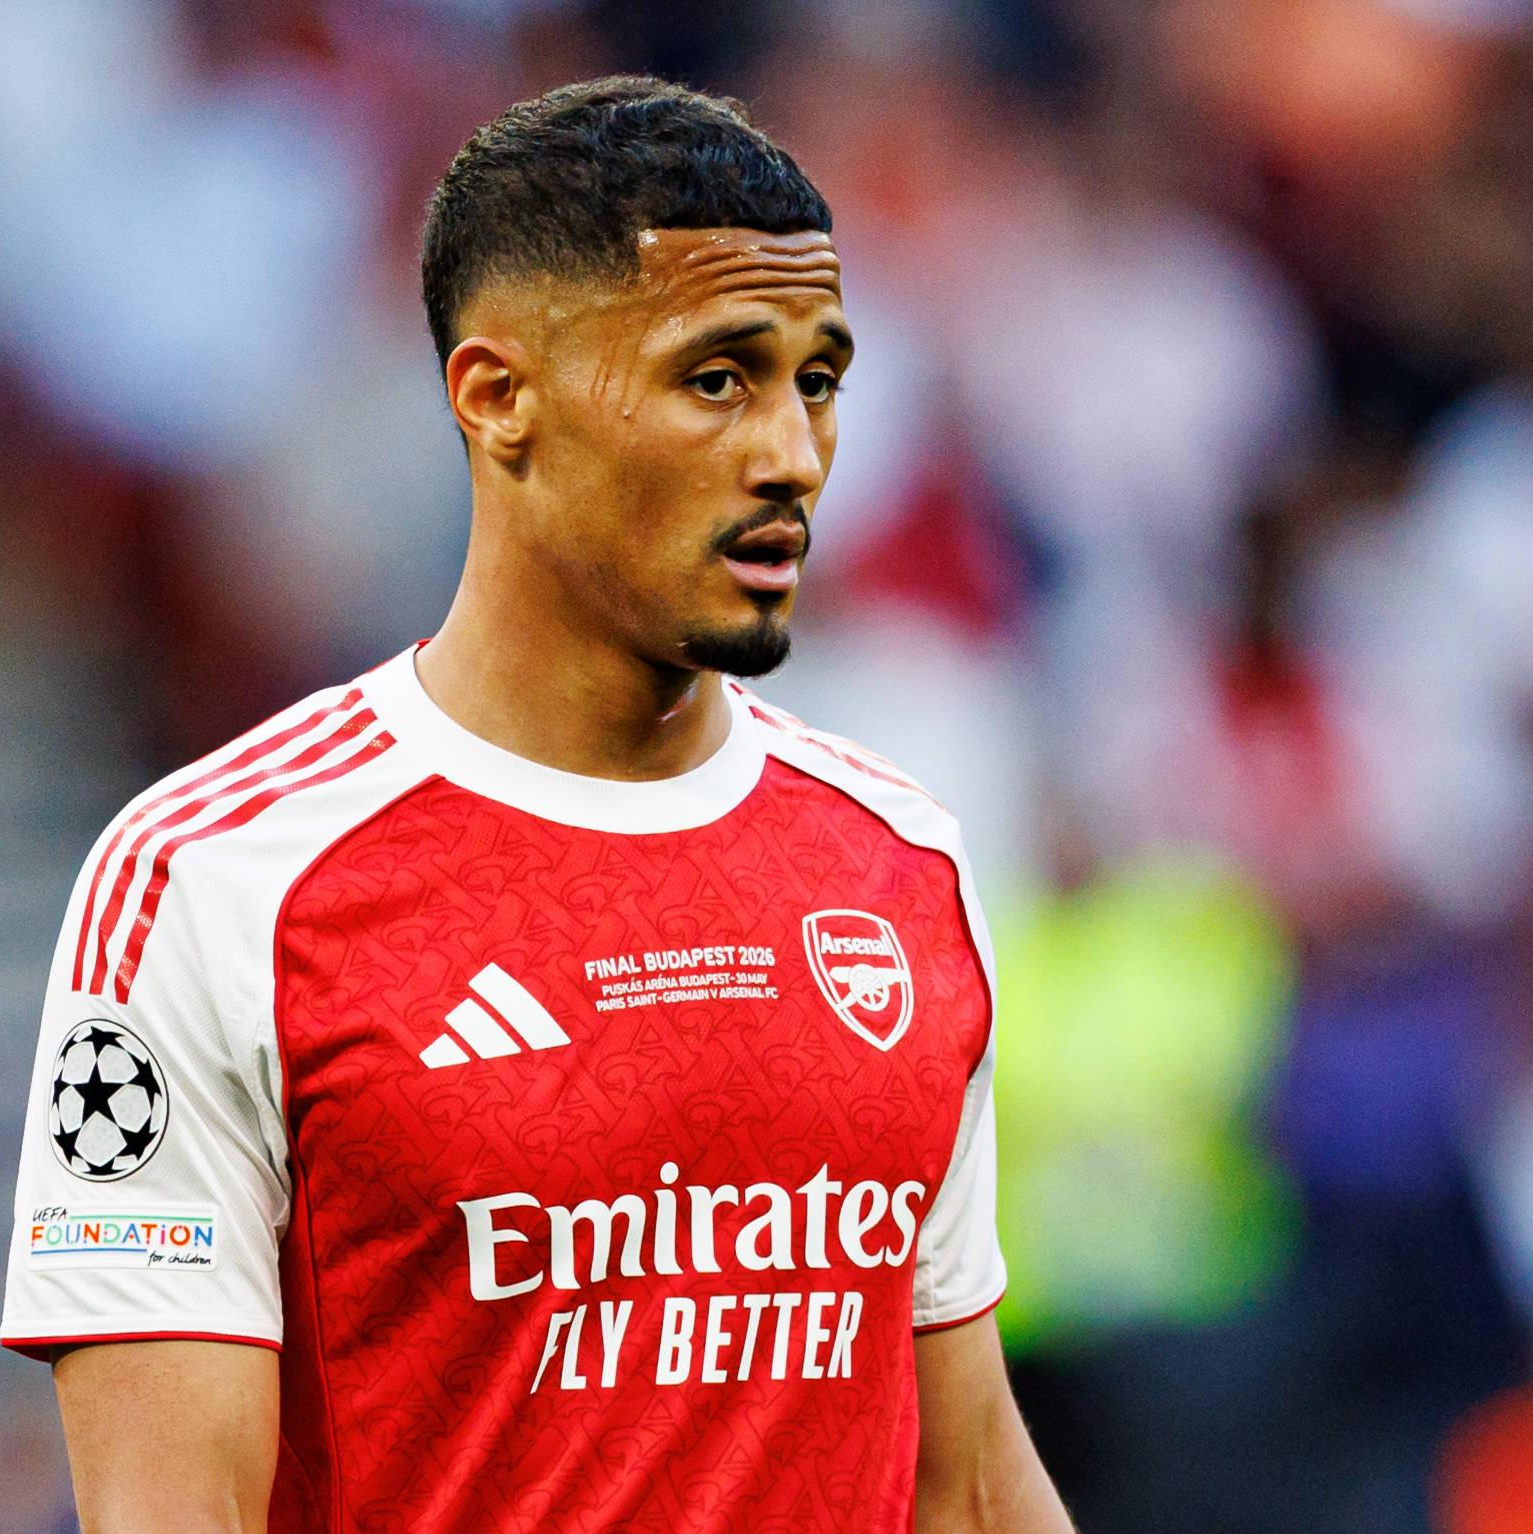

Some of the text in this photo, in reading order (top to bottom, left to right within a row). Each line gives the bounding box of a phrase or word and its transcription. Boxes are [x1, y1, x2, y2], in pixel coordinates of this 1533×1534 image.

[820, 931, 893, 957] Arsenal
[584, 945, 776, 981] FINAL BUDAPEST 2026
[601, 976, 643, 997] PUSKÁS
[645, 973, 678, 991] ARÉNA
[747, 973, 768, 985] MAY
[595, 997, 626, 1012] PARIS
[710, 988, 718, 999] V
[719, 987, 765, 999] ARSENAL
[32, 1206, 68, 1222] UEFA
[456, 1161, 927, 1301] Emirates
[147, 1250, 211, 1266] for children
[530, 1291, 864, 1395] FLY BETTER
